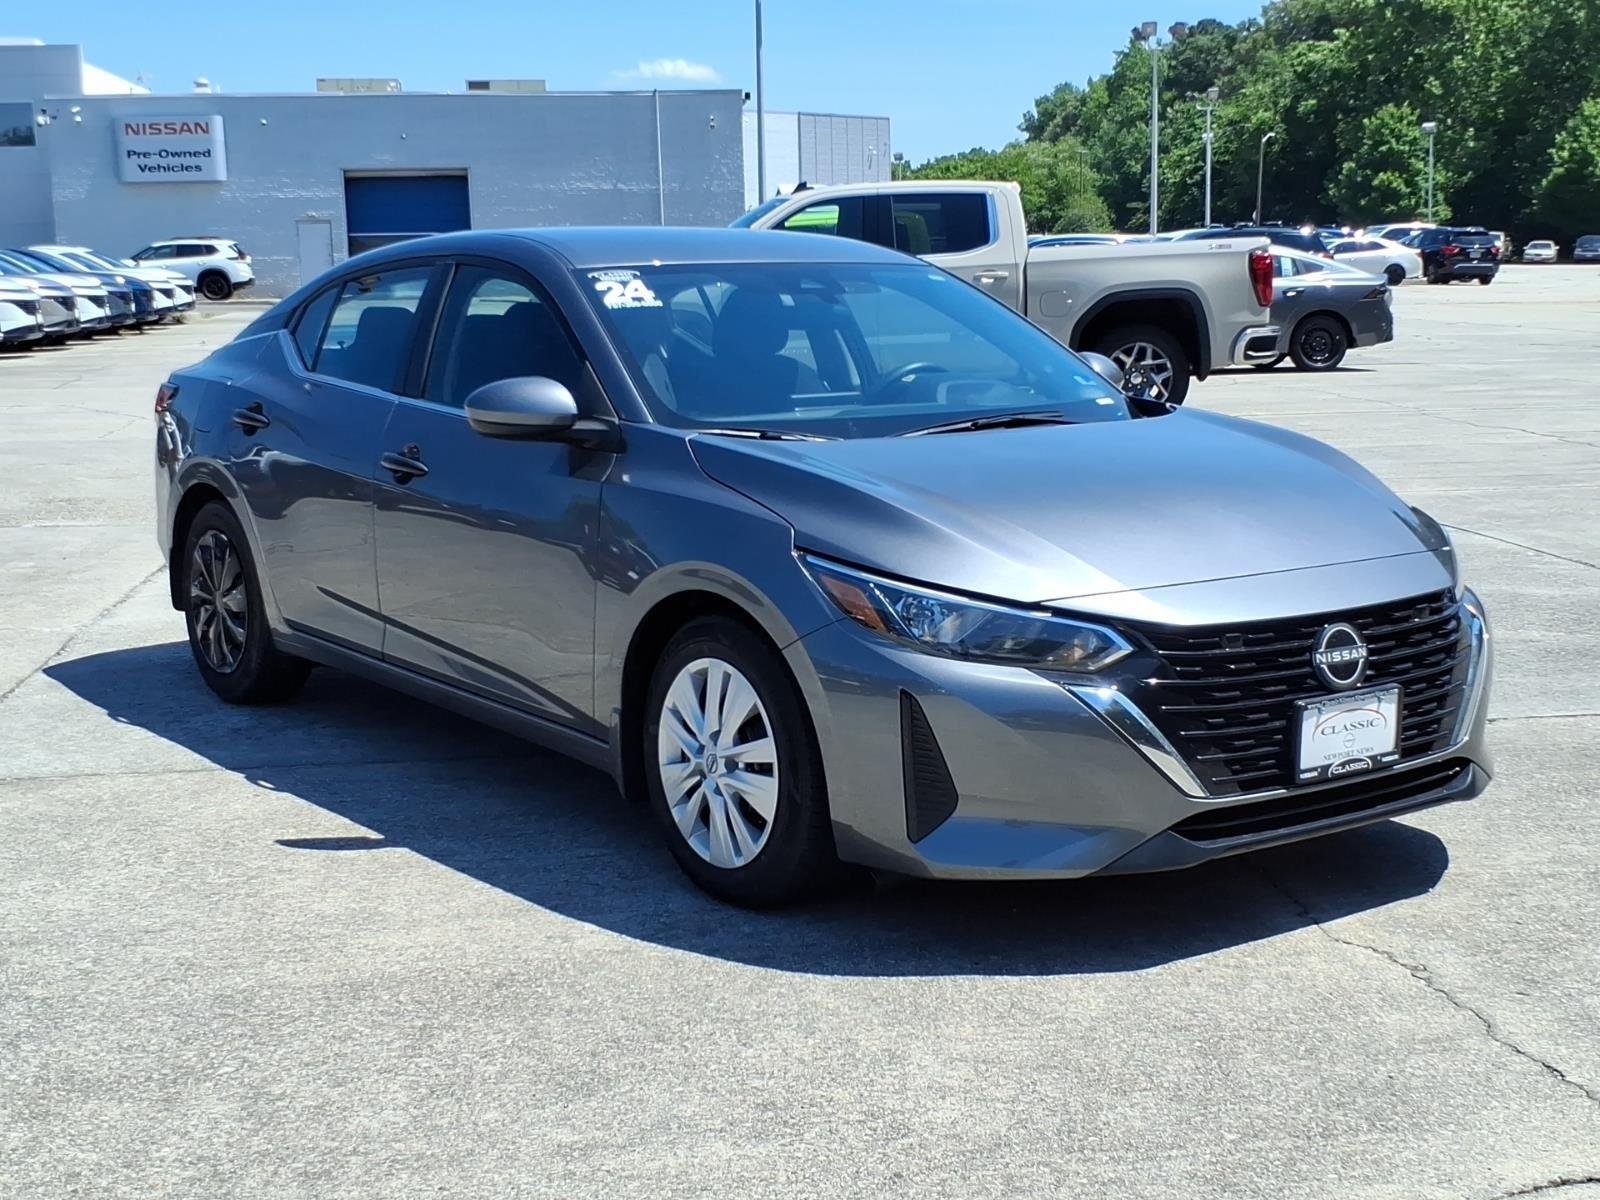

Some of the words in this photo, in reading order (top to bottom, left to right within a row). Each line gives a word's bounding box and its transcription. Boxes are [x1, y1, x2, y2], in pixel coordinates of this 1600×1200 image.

[124, 121, 209, 136] NISSAN
[126, 148, 211, 159] Pre-Owned
[137, 163, 202, 173] Vehicles
[594, 280, 656, 305] 24
[1315, 647, 1367, 664] NISSAN
[1320, 717, 1381, 736] CLASSIC
[1332, 761, 1369, 774] CLASSIC
